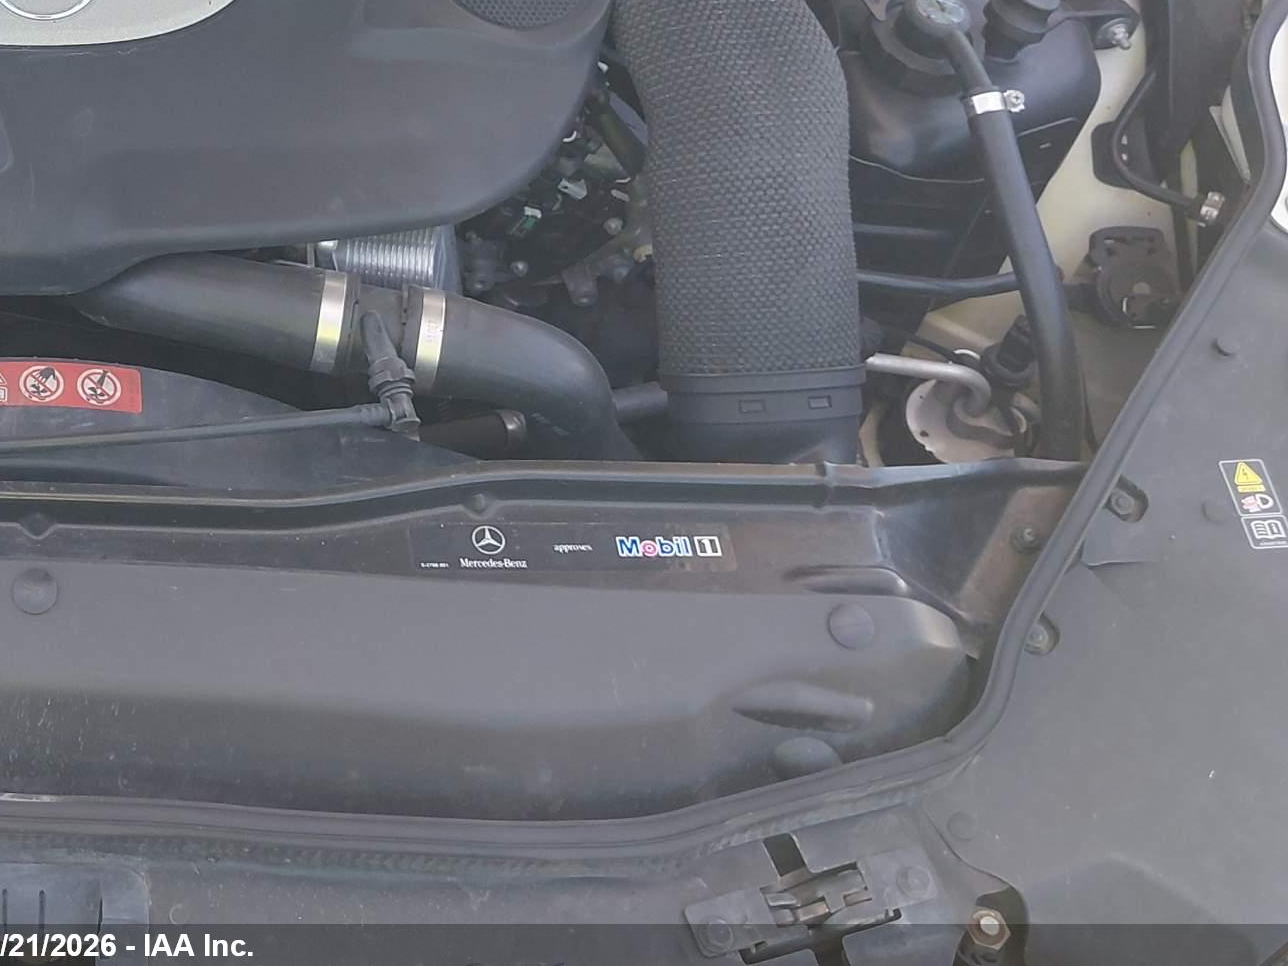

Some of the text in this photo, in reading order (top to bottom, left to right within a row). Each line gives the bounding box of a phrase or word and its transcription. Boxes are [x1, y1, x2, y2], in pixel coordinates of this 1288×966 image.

[615, 536, 721, 557] Mobil 1
[459, 558, 528, 568] Mercedes-Benz
